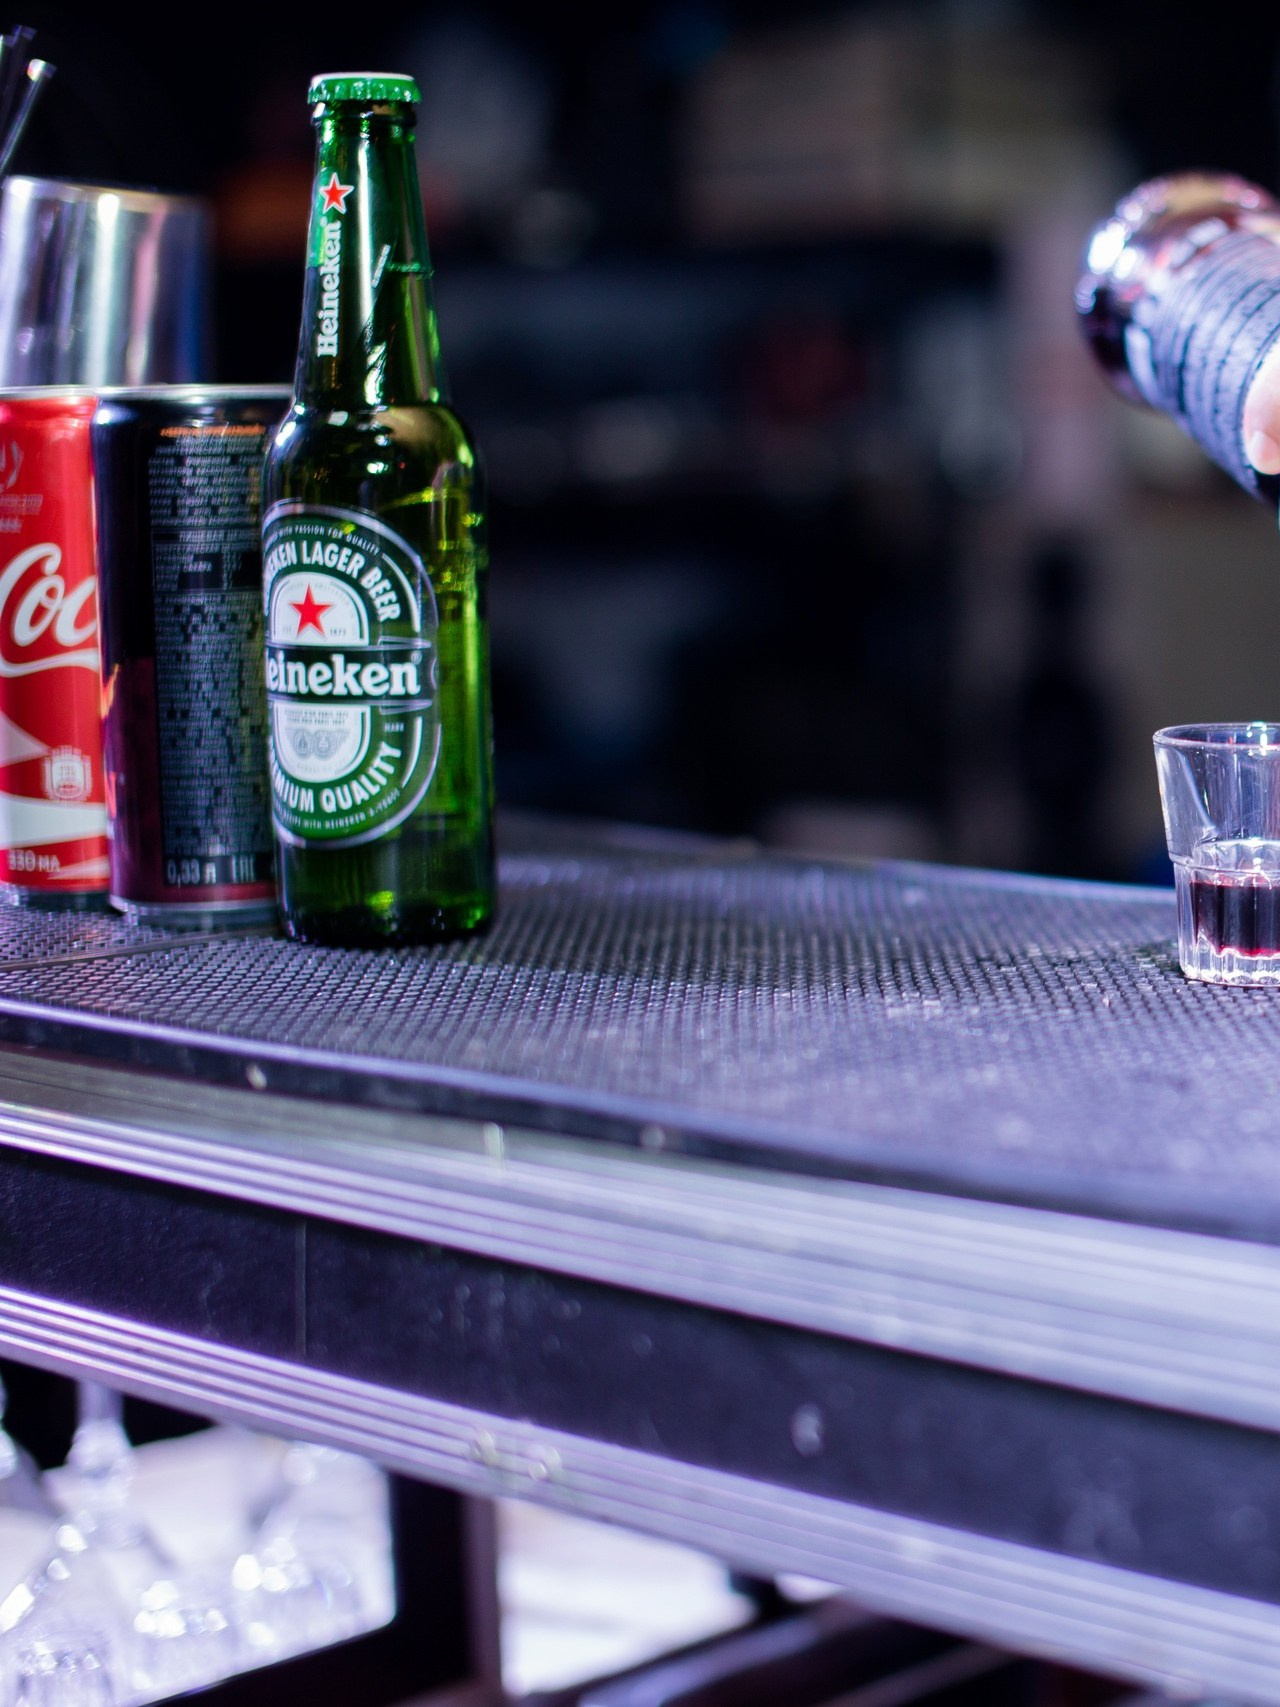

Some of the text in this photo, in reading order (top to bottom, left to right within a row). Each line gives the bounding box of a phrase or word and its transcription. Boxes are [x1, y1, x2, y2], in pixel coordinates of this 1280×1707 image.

[317, 220, 342, 358] Heineken
[295, 525, 325, 536] PASSION
[328, 527, 344, 540] FOR
[346, 534, 381, 557] QUALITY
[301, 540, 366, 579] LAGER
[361, 567, 401, 623] BEER
[266, 652, 421, 696] eineken
[321, 741, 401, 813] QUALITY
[9, 849, 36, 872] 330
[167, 858, 201, 888] 0,33
